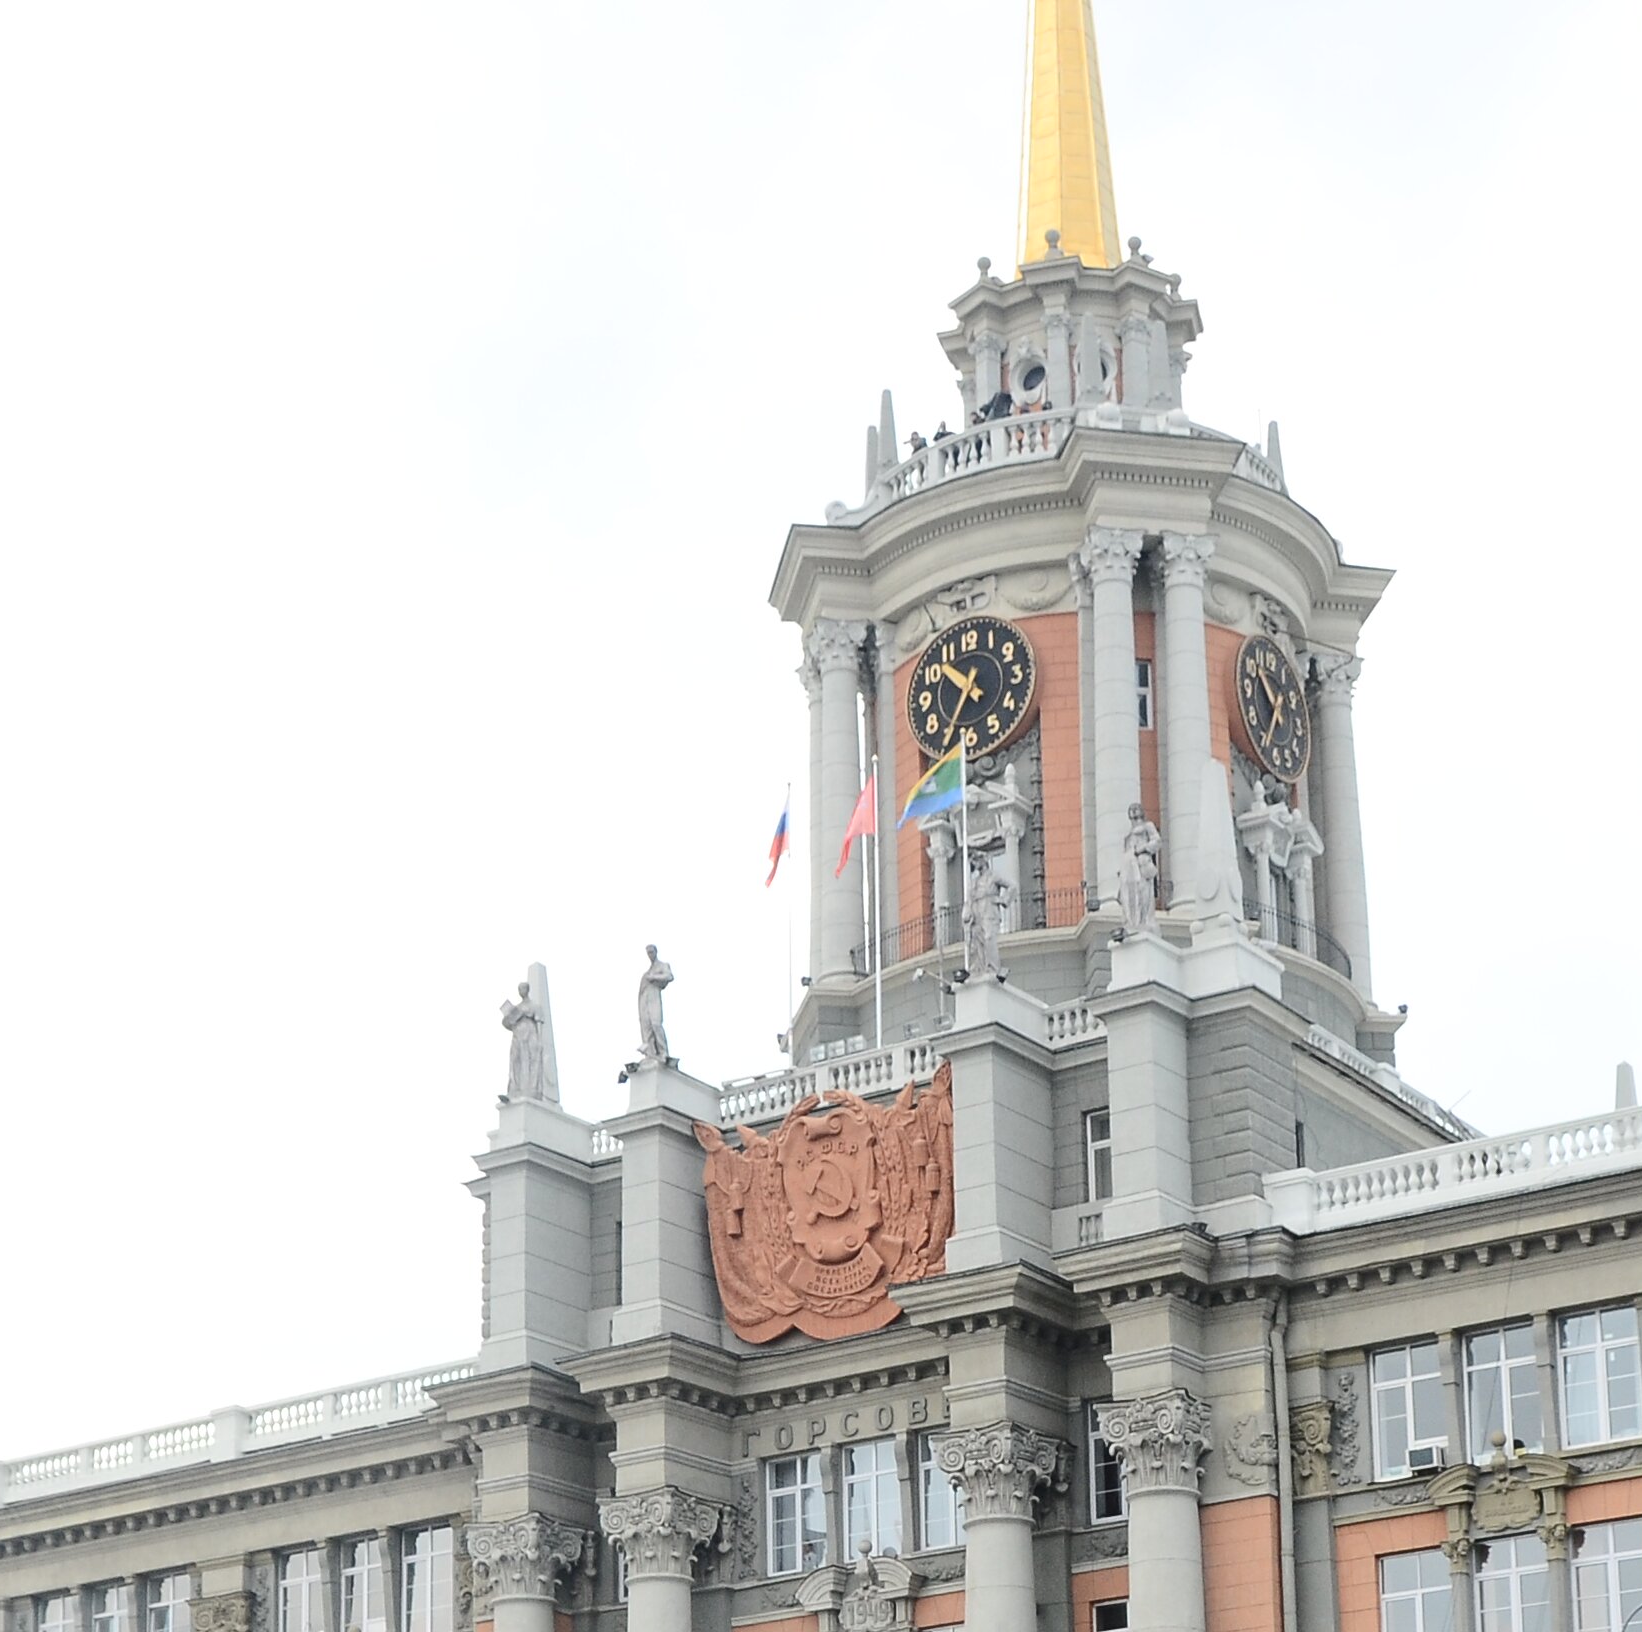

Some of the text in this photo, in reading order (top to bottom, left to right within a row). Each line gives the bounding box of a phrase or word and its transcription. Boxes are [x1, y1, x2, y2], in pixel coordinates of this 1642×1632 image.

[961, 630, 978, 652] 12
[1002, 641, 1014, 663] 2
[942, 642, 955, 663] 11
[924, 663, 941, 686] 10
[1010, 663, 1023, 685] 3
[919, 691, 932, 712] 9
[1002, 690, 1015, 711] 4
[925, 713, 939, 735] 8
[987, 713, 1000, 735] 5
[965, 726, 978, 747] 6
[846, 1600, 890, 1627] 1949
